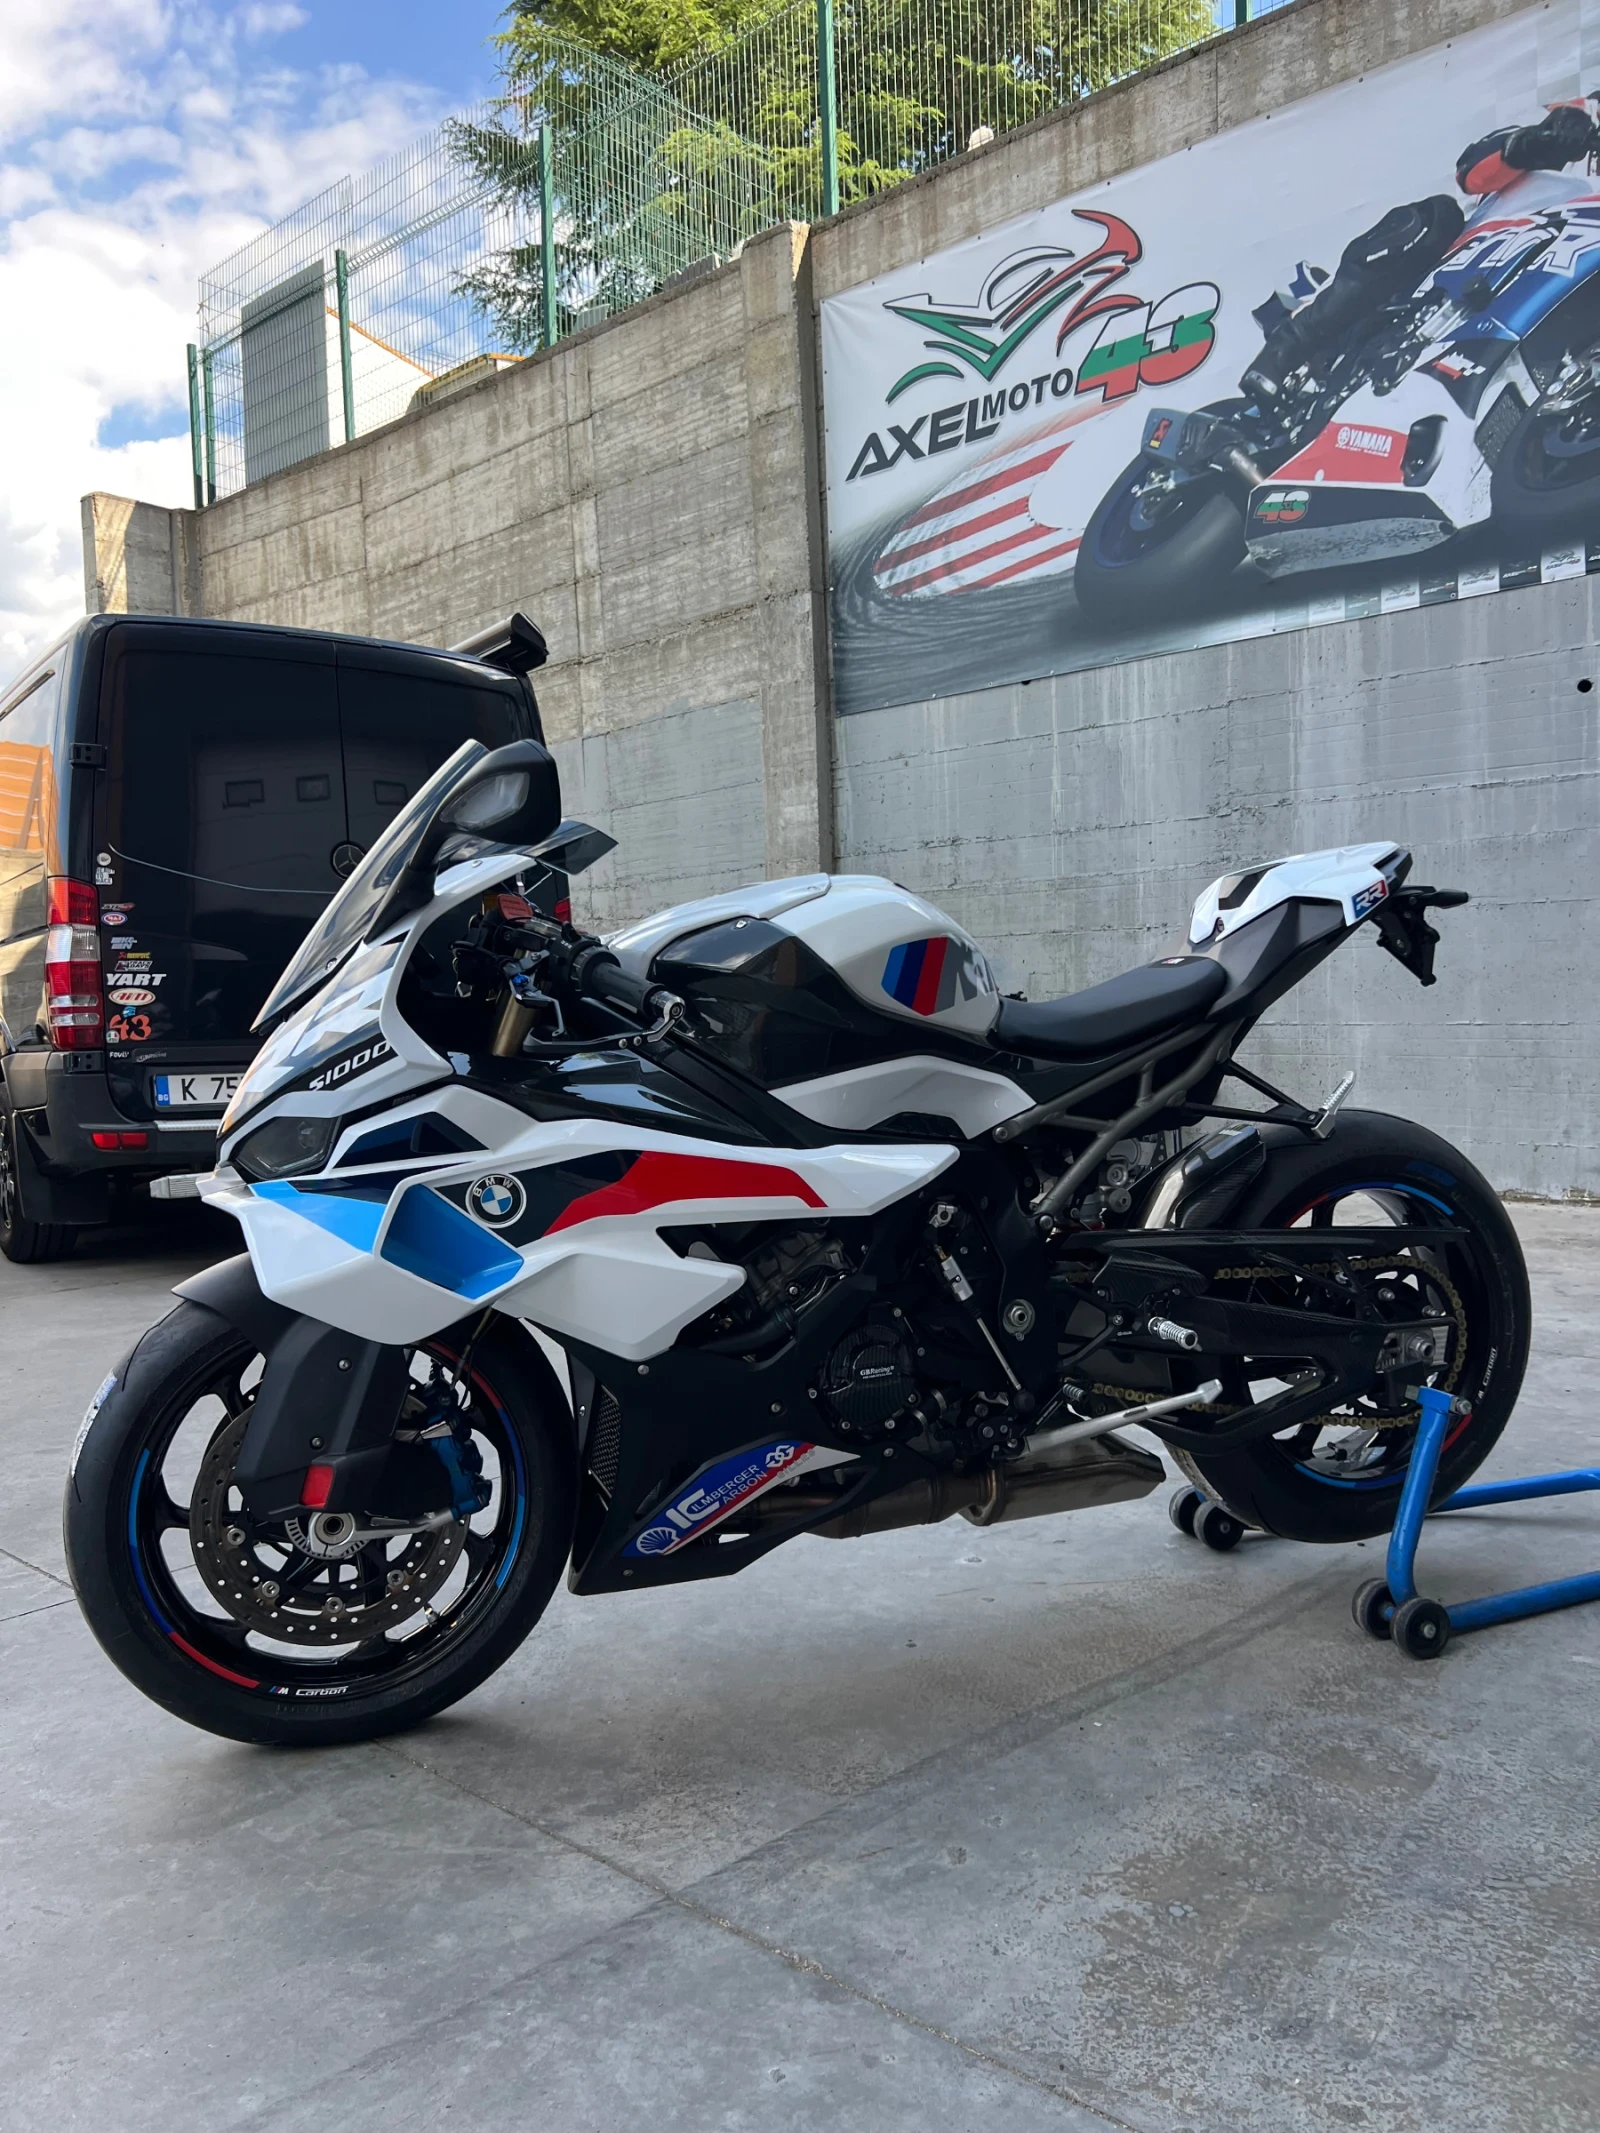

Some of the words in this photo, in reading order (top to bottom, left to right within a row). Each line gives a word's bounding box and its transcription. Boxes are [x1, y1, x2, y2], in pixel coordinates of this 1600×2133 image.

[1074, 281, 1221, 403] 43
[1350, 428, 1392, 453] YAMAHA
[1356, 882, 1384, 910] RR
[106, 974, 167, 986] YART
[109, 1014, 152, 1041] 43
[309, 1041, 391, 1091] S1000
[181, 1078, 197, 1101] K
[211, 1077, 242, 1100] 75
[473, 1176, 513, 1197] BMW
[777, 1448, 816, 1480] GILLES
[691, 1464, 760, 1512] ILMBERGER
[295, 1685, 350, 1697] Carbon
